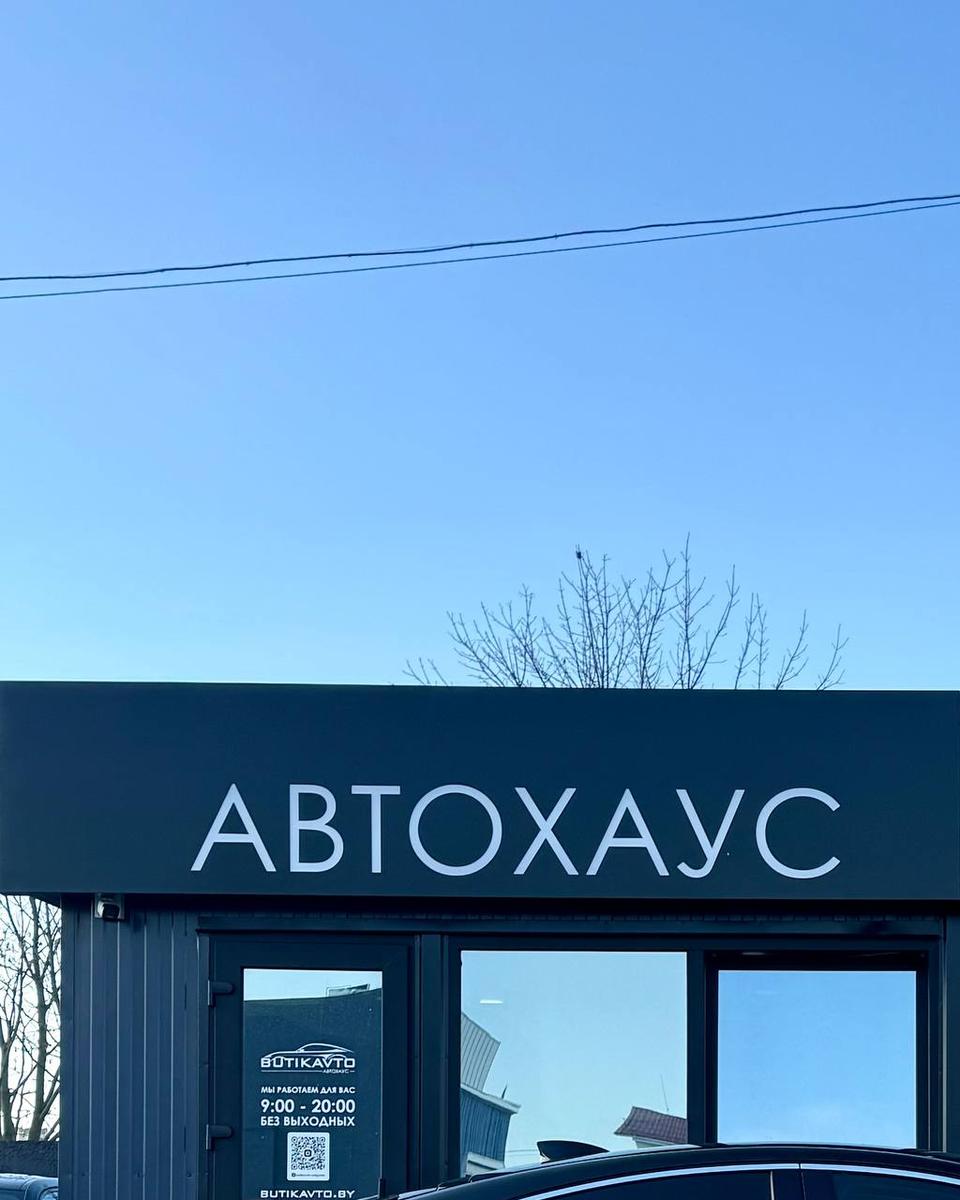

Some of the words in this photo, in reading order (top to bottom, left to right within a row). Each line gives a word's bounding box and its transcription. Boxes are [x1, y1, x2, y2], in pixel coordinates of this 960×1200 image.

[191, 783, 841, 880] АВТОХАУС
[260, 1057, 356, 1069] BUTIKAVTO
[260, 1086, 276, 1094] МЫ
[277, 1086, 319, 1094] РАБОТАЕМ
[320, 1086, 337, 1095] ДЛЯ
[338, 1086, 356, 1094] ВАС
[260, 1099, 295, 1113] 9:00
[311, 1099, 356, 1113] 20:00
[260, 1116, 280, 1127] БЕЗ
[283, 1116, 356, 1128] ВЫХОДНЫХ
[260, 1189, 356, 1199] BUTIKAVTO.BY
